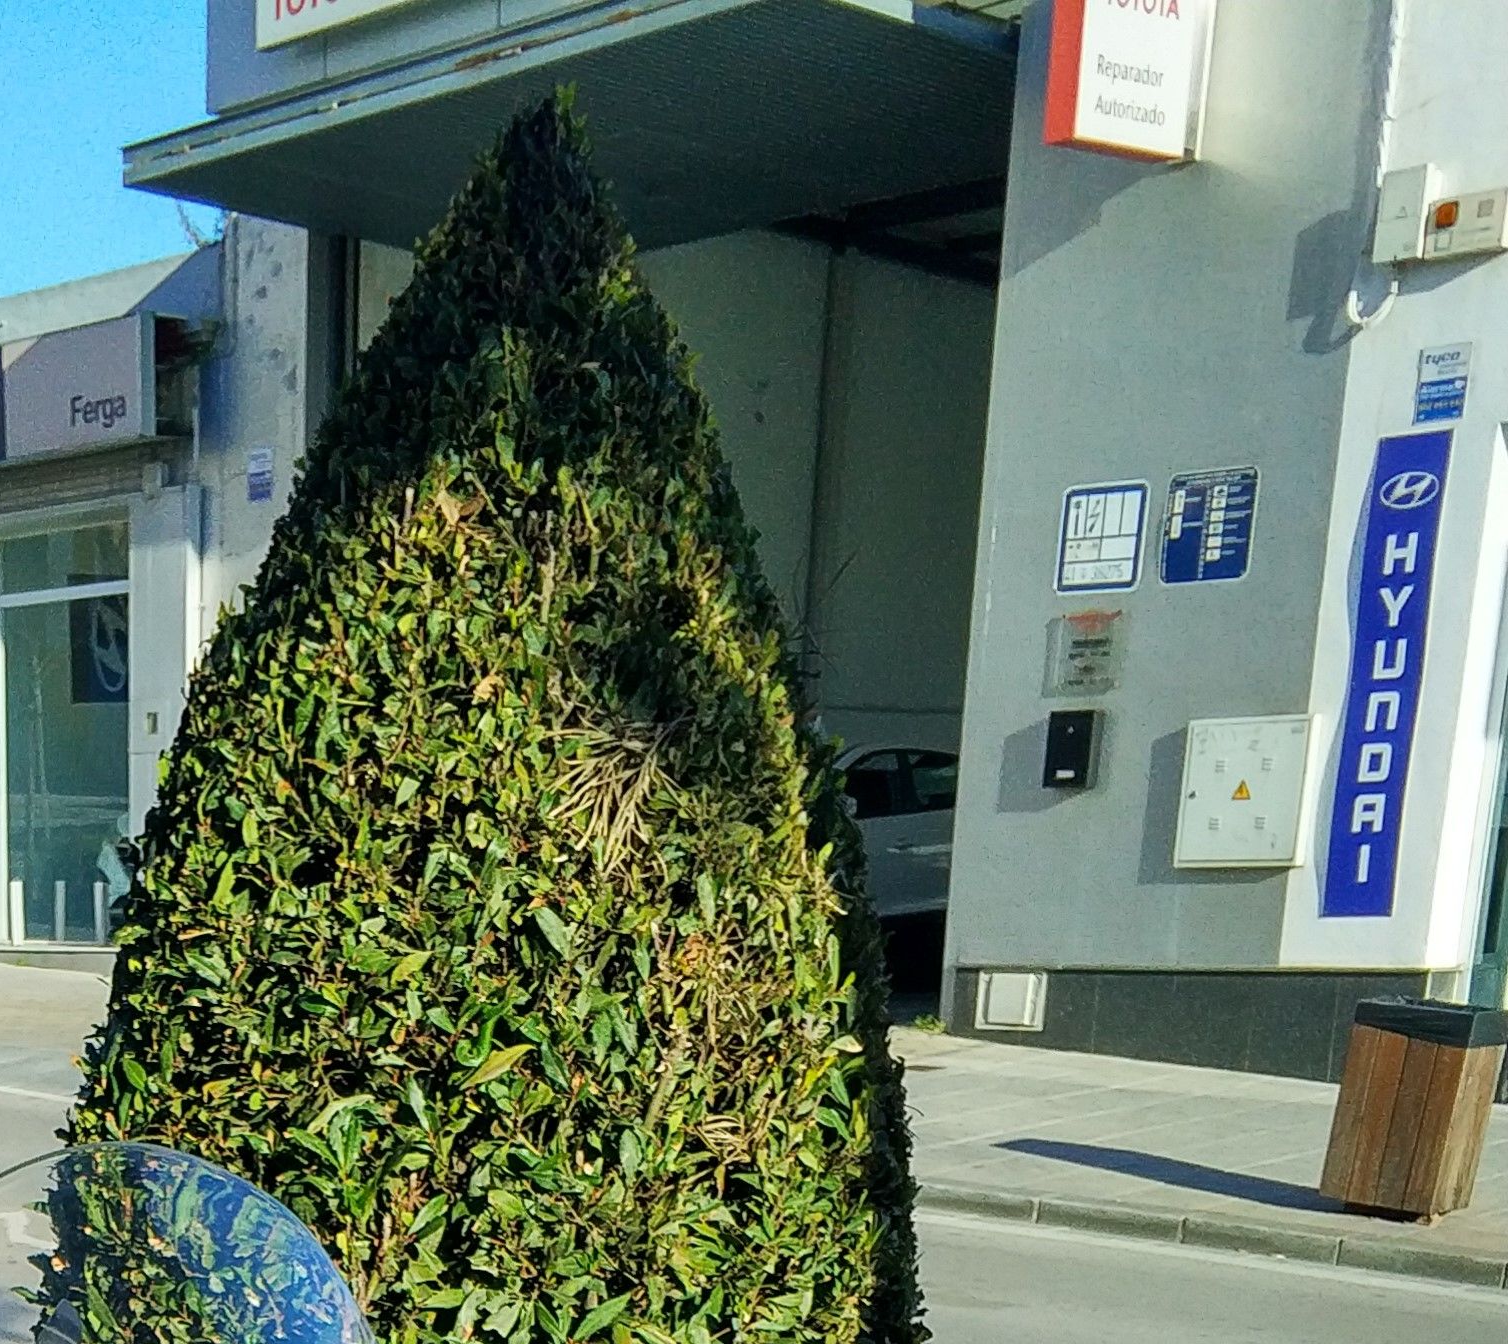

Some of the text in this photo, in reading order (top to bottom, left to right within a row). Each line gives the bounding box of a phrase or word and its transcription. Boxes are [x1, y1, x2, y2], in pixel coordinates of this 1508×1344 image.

[1097, 54, 1164, 88] Reparador
[1095, 95, 1166, 126] Autorizado
[69, 394, 128, 428] Ferga
[1351, 531, 1419, 884] HYUNDAI
